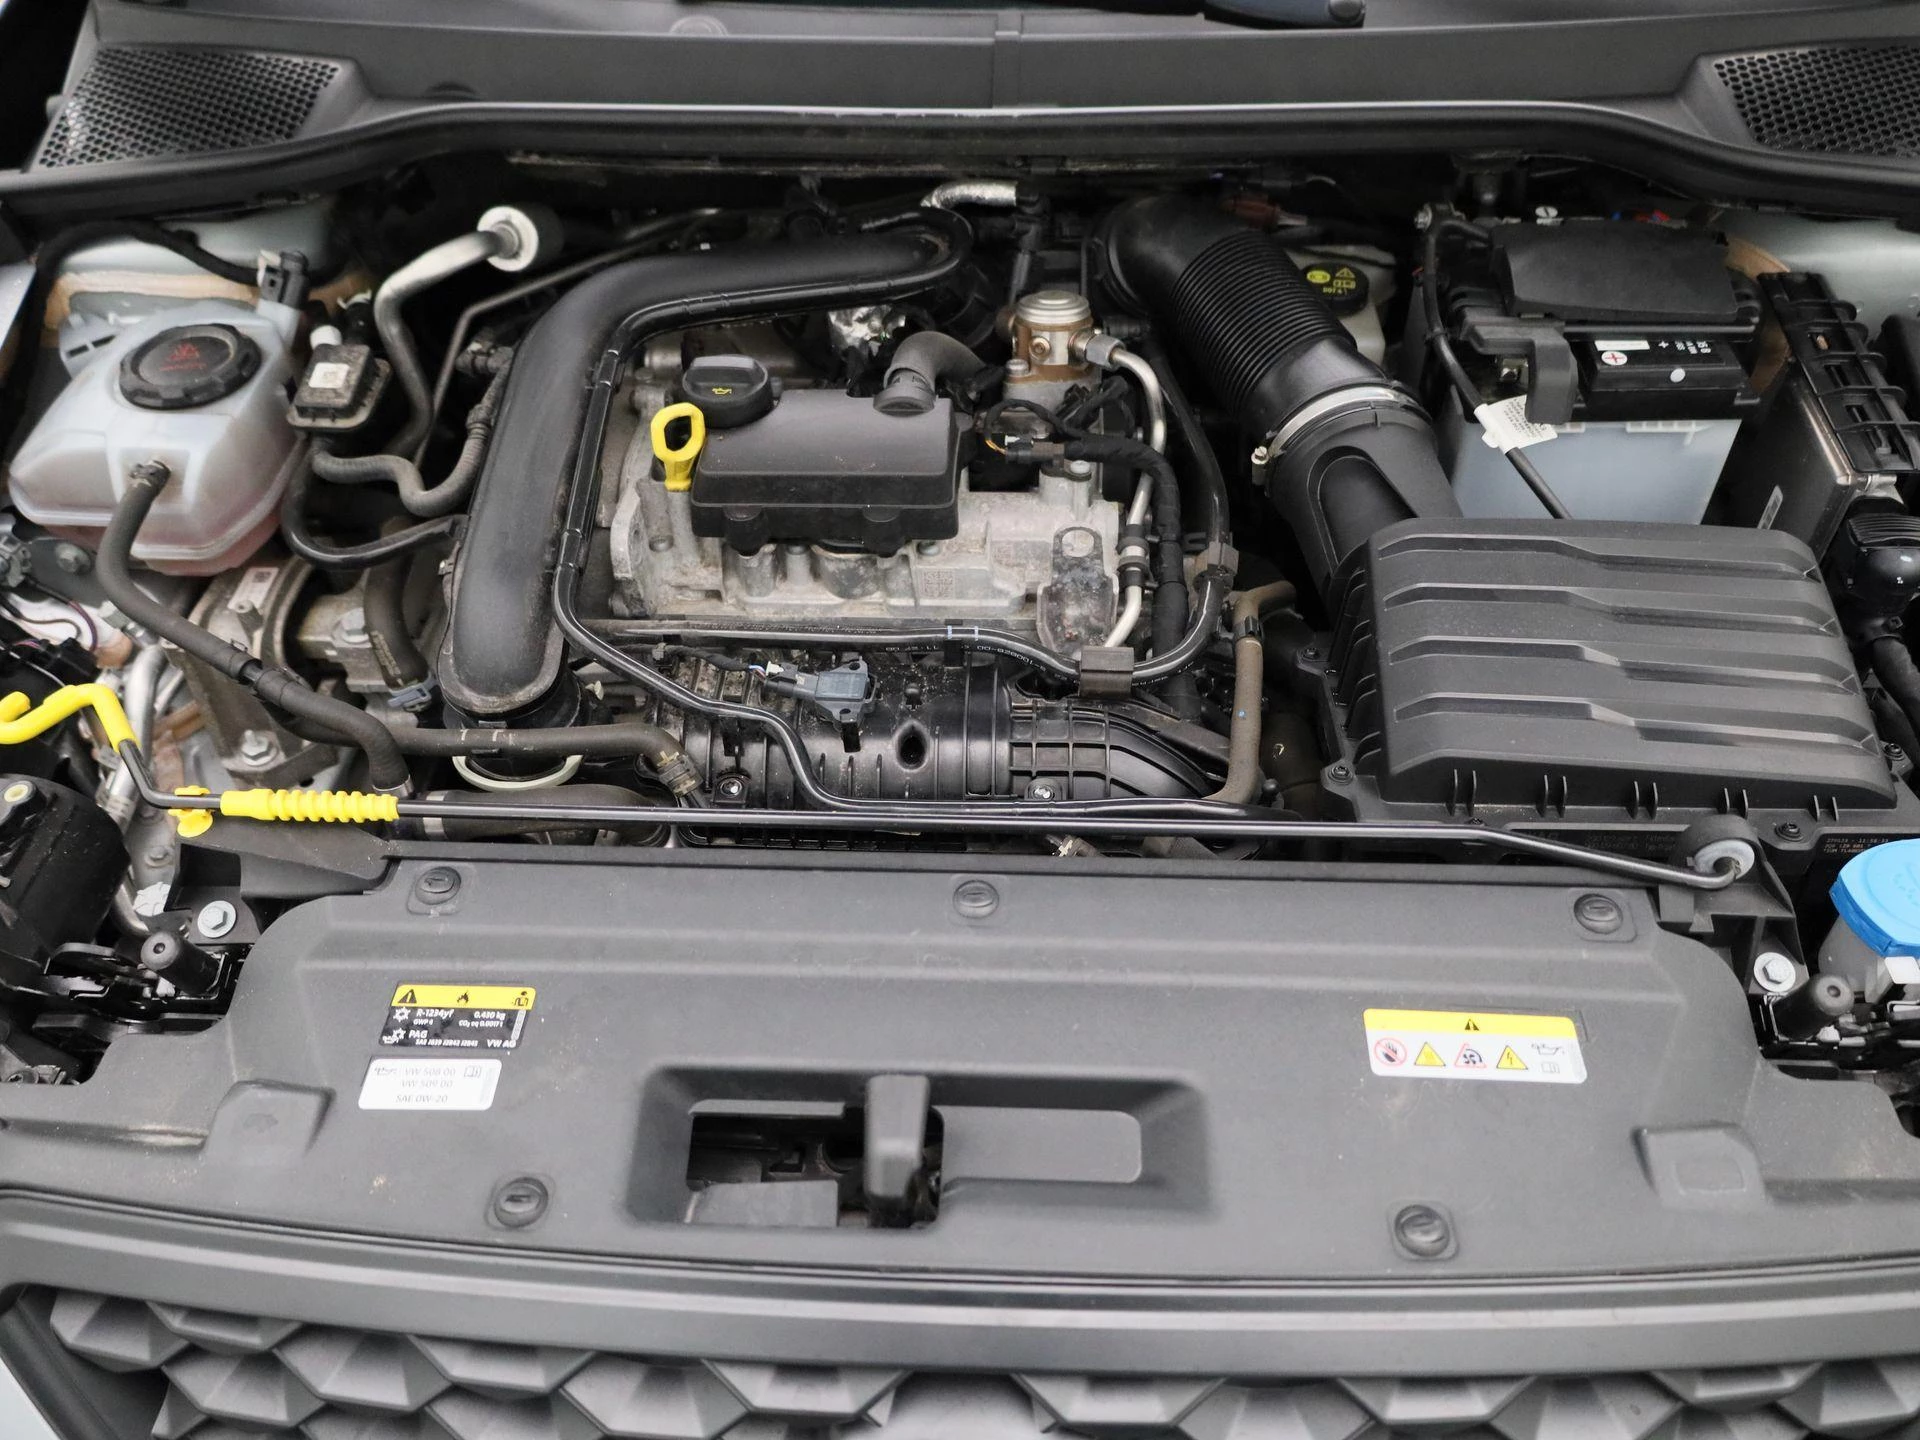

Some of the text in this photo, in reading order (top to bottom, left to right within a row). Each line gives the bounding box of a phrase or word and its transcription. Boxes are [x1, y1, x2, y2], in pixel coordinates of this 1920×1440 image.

[416, 1008, 454, 1019] R-1234yf
[496, 1011, 506, 1020] kg
[409, 1030, 428, 1038] PAG
[487, 1039, 502, 1048] VW
[502, 1040, 516, 1048] AG
[405, 1068, 421, 1076] VW
[443, 1068, 456, 1076] 00
[402, 1080, 417, 1088] VW
[440, 1080, 453, 1088] 00
[395, 1095, 412, 1104] SAE
